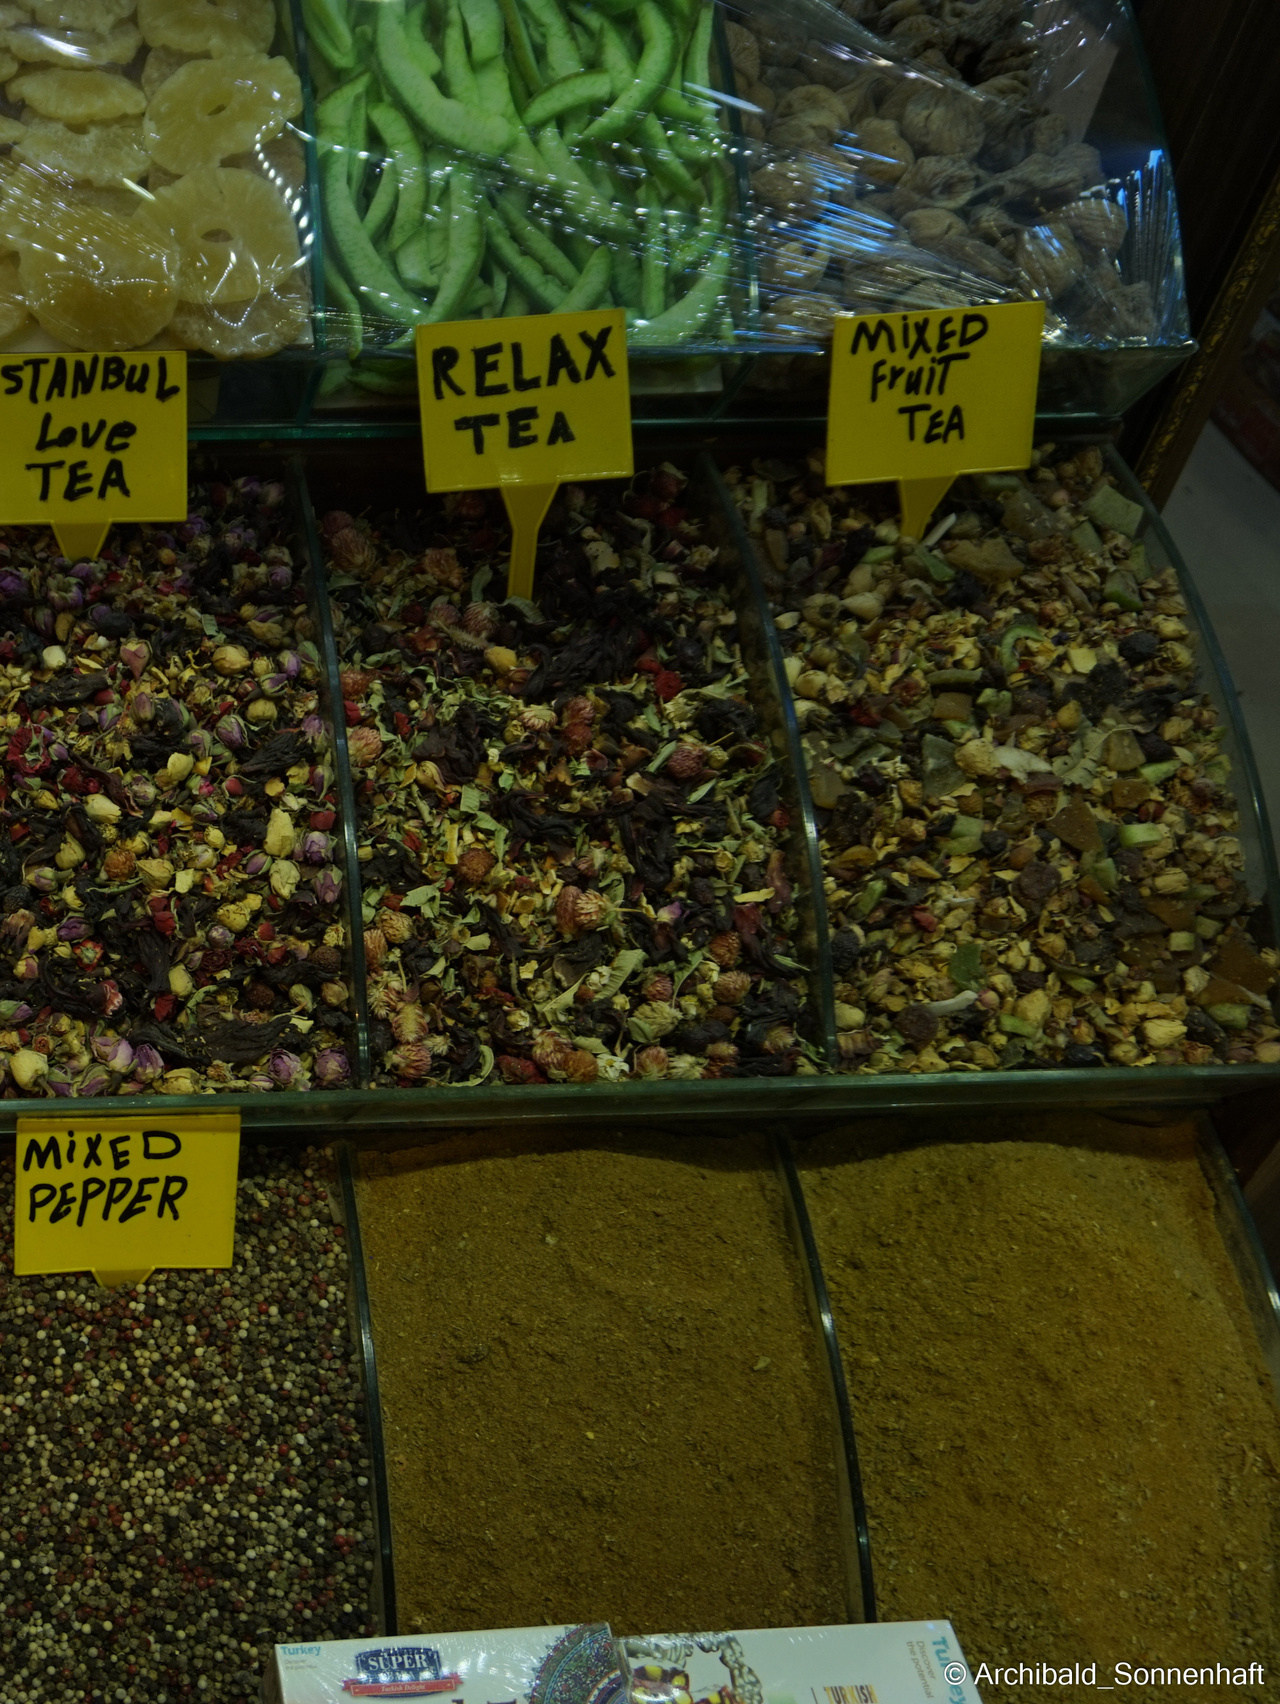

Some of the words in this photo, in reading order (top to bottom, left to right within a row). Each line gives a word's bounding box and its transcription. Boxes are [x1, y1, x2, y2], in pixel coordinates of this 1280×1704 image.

[432, 326, 616, 400] RELAX
[454, 406, 576, 455] TEA
[898, 403, 964, 443] TEA
[25, 458, 130, 502] TEA
[29, 1176, 188, 1227] PEPPER
[280, 1644, 321, 1657] Turkey
[916, 1640, 936, 1680] Discover
[912, 1657, 934, 1699] potential
